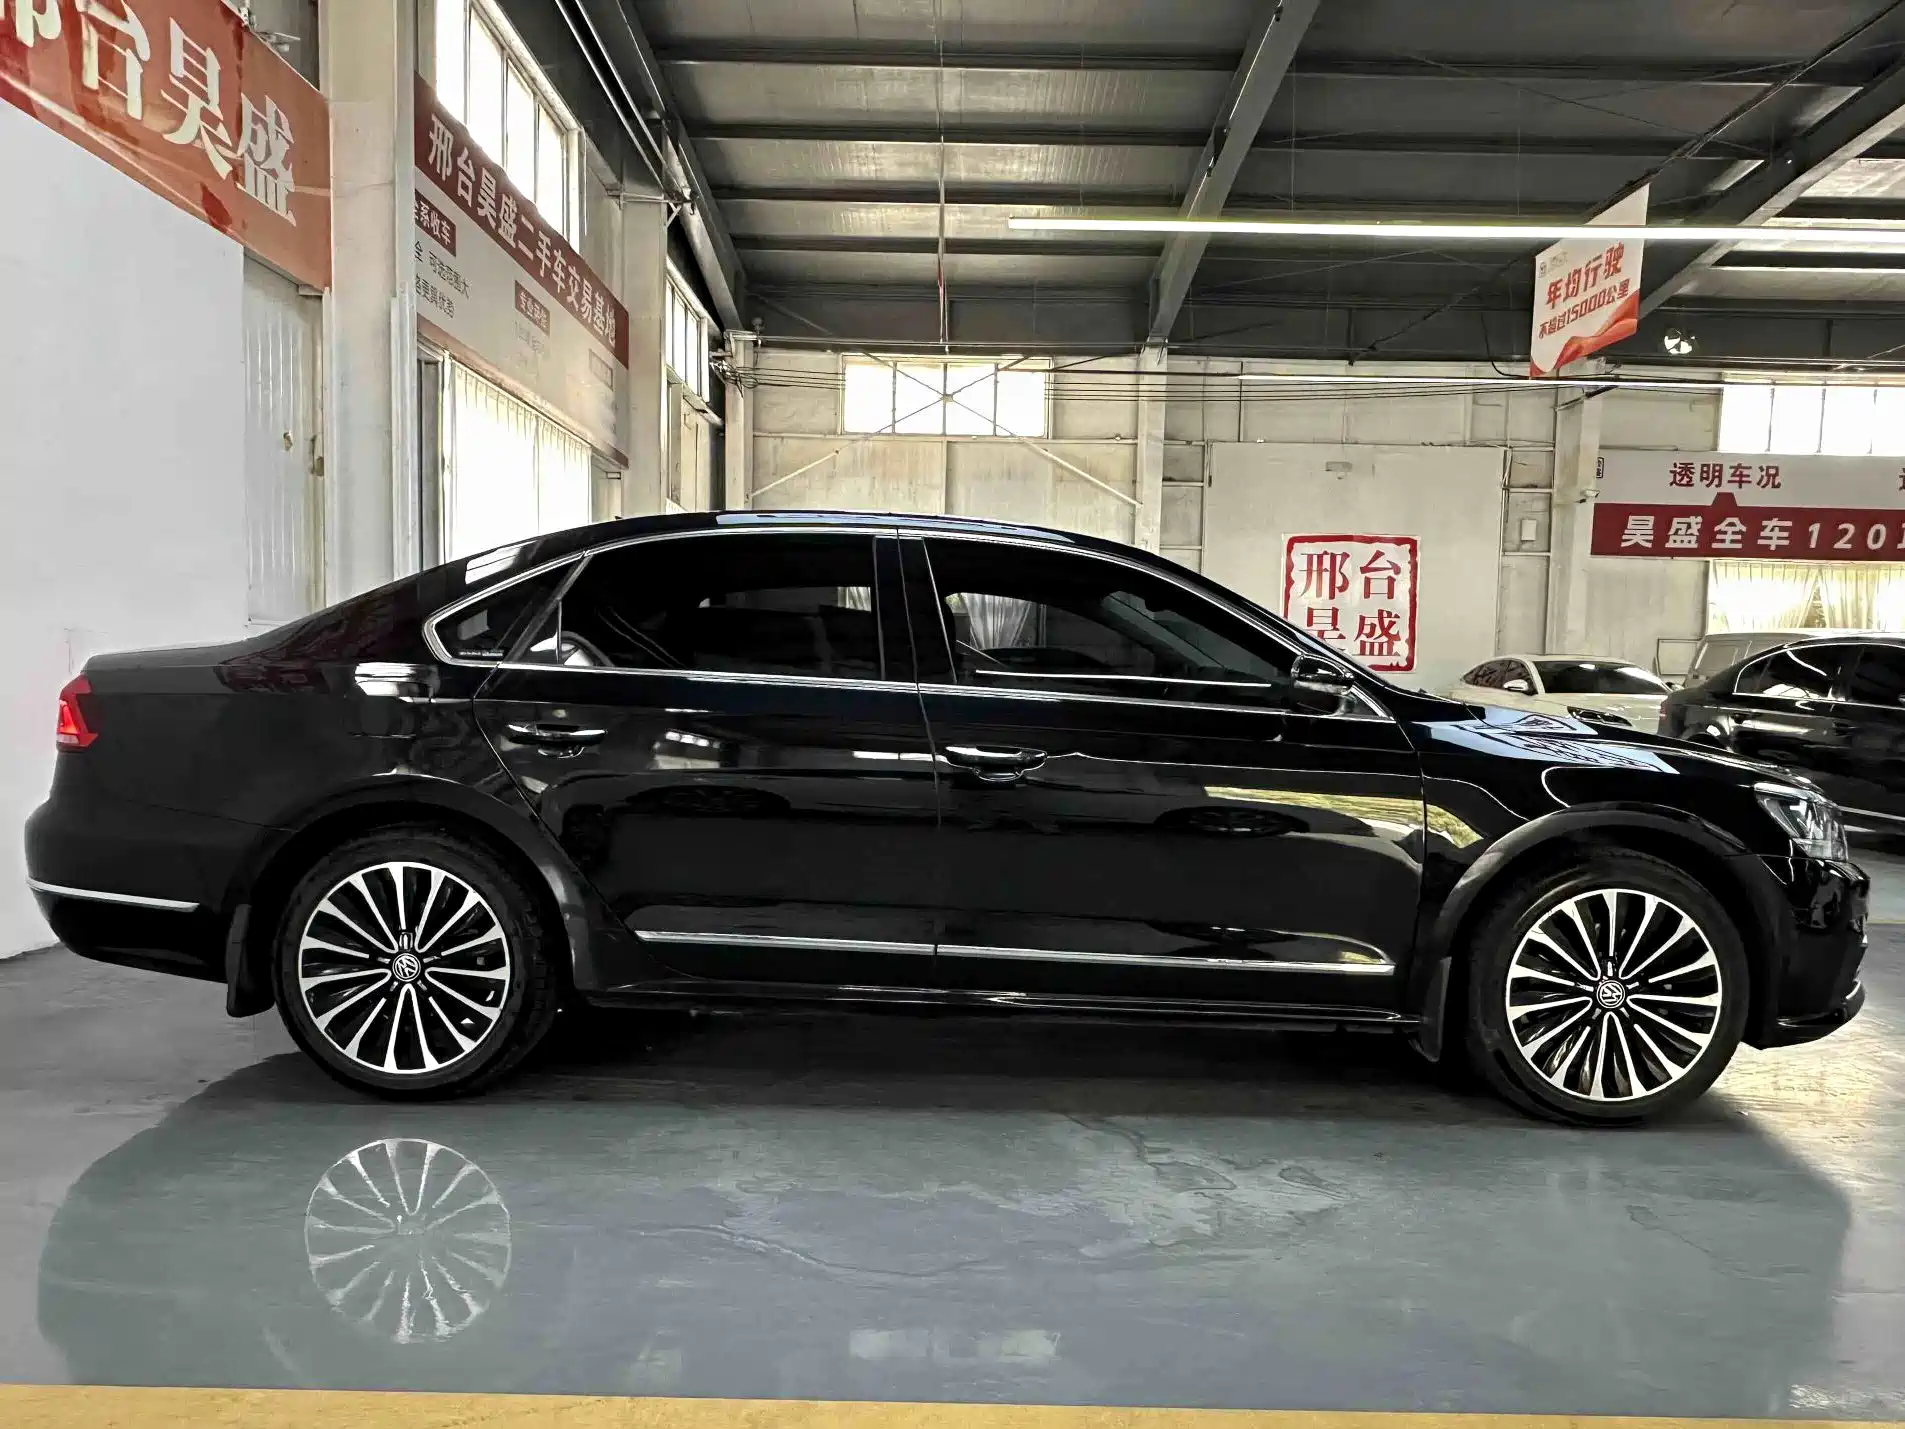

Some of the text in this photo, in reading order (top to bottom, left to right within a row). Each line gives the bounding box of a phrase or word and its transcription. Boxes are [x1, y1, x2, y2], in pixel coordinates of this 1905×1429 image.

[428, 113, 616, 349] 邢台昊盛二手车交易基地
[1546, 242, 1625, 310] 年均行驶
[1539, 278, 1630, 339] 不超过15000公里
[1669, 462, 1782, 489] 透明车况
[1299, 550, 1401, 600] 邢台
